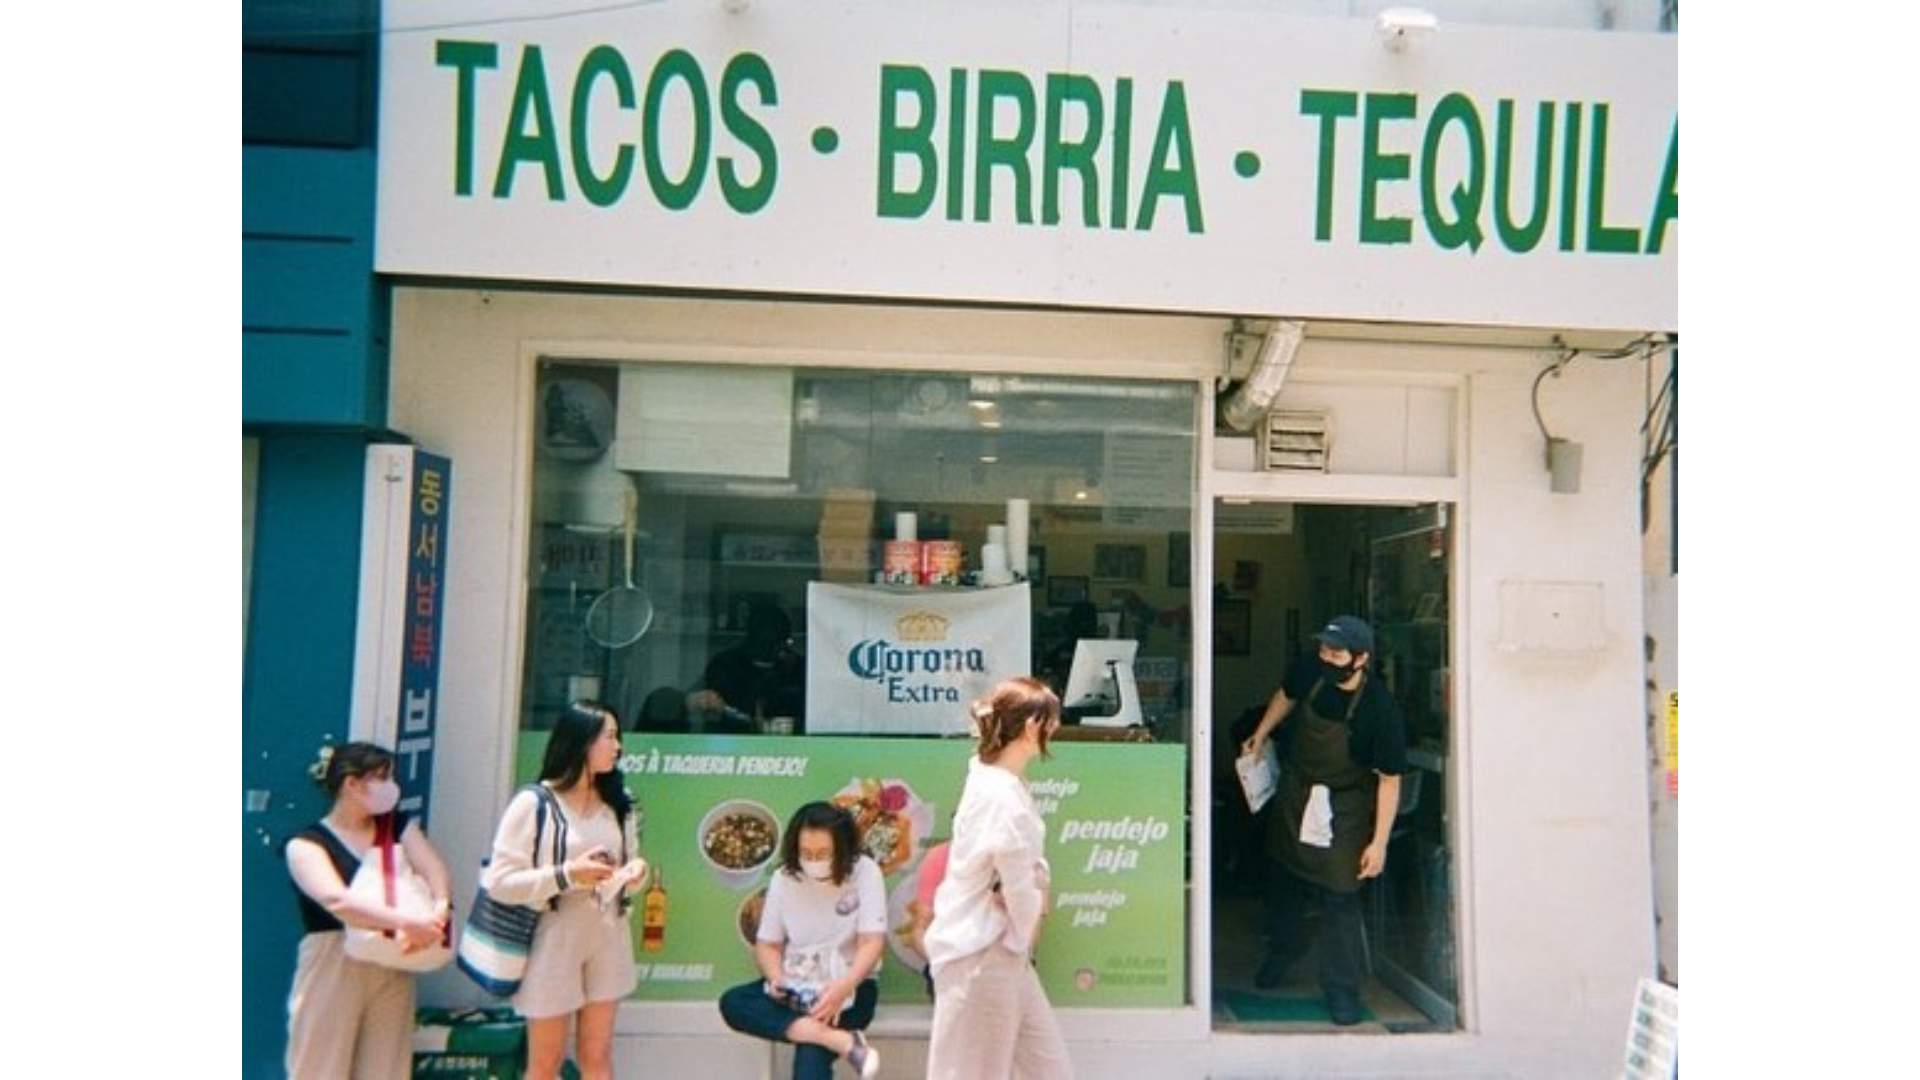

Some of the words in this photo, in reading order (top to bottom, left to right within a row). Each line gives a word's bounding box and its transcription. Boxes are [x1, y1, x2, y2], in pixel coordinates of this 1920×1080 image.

[436, 40, 779, 214] TACOS
[876, 64, 1205, 233] BIRRIA
[848, 639, 986, 684] Corona
[888, 676, 959, 703] Extra
[1060, 816, 1168, 845] pendejo
[1084, 845, 1138, 873] jaja
[1057, 890, 1125, 907] pendejo
[1073, 909, 1107, 927] jaja
